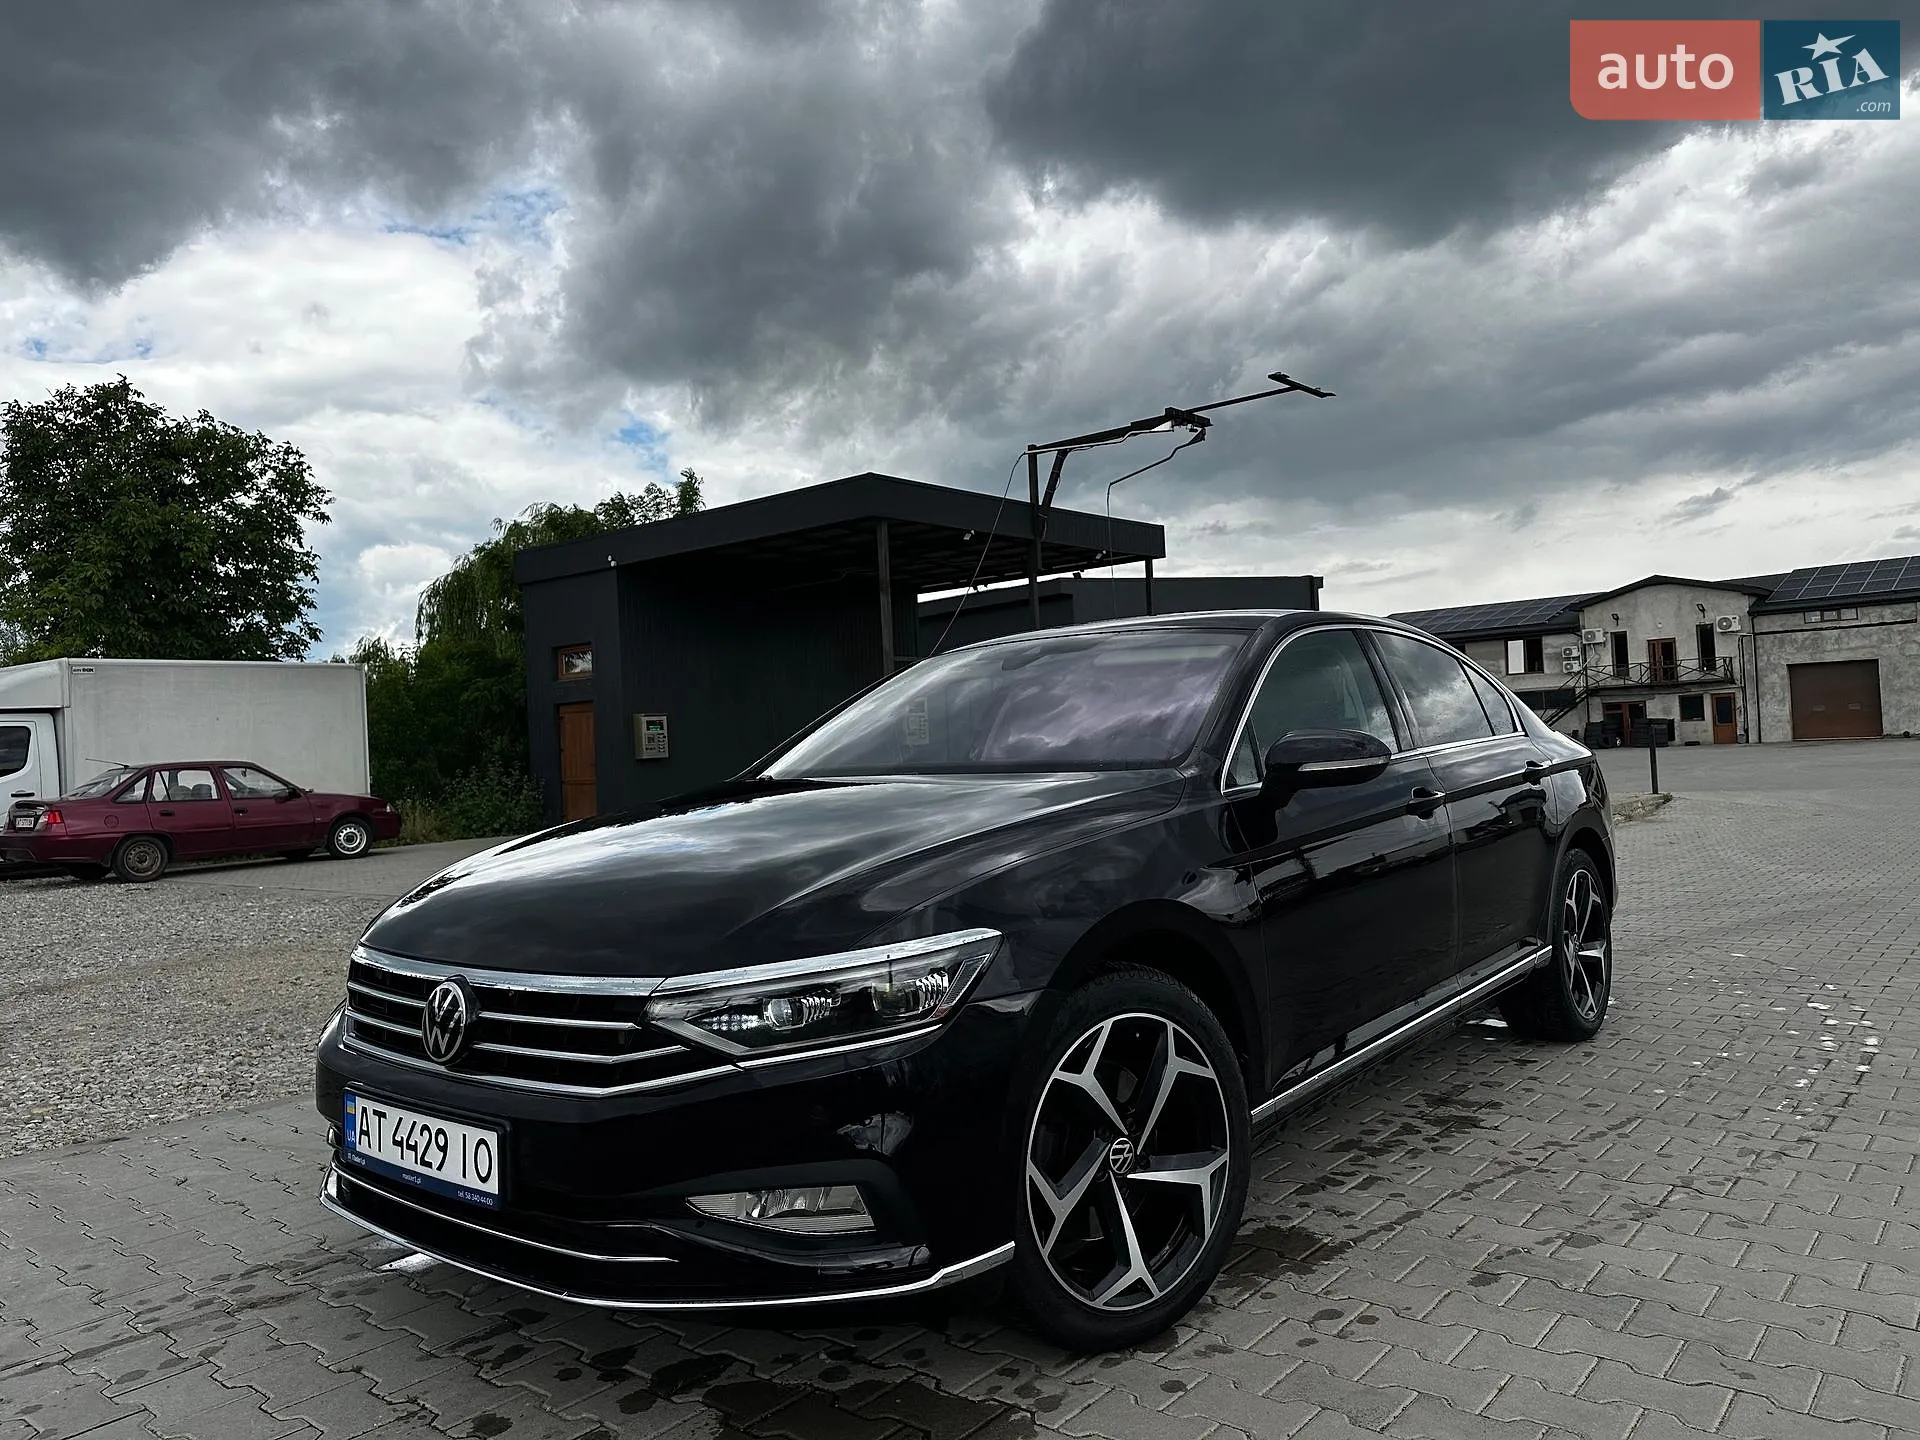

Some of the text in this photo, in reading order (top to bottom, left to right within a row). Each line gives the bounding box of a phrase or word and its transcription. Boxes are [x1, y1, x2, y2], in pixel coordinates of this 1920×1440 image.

[346, 1129, 356, 1143] UA
[358, 1105, 493, 1184] AT 4429 IO
